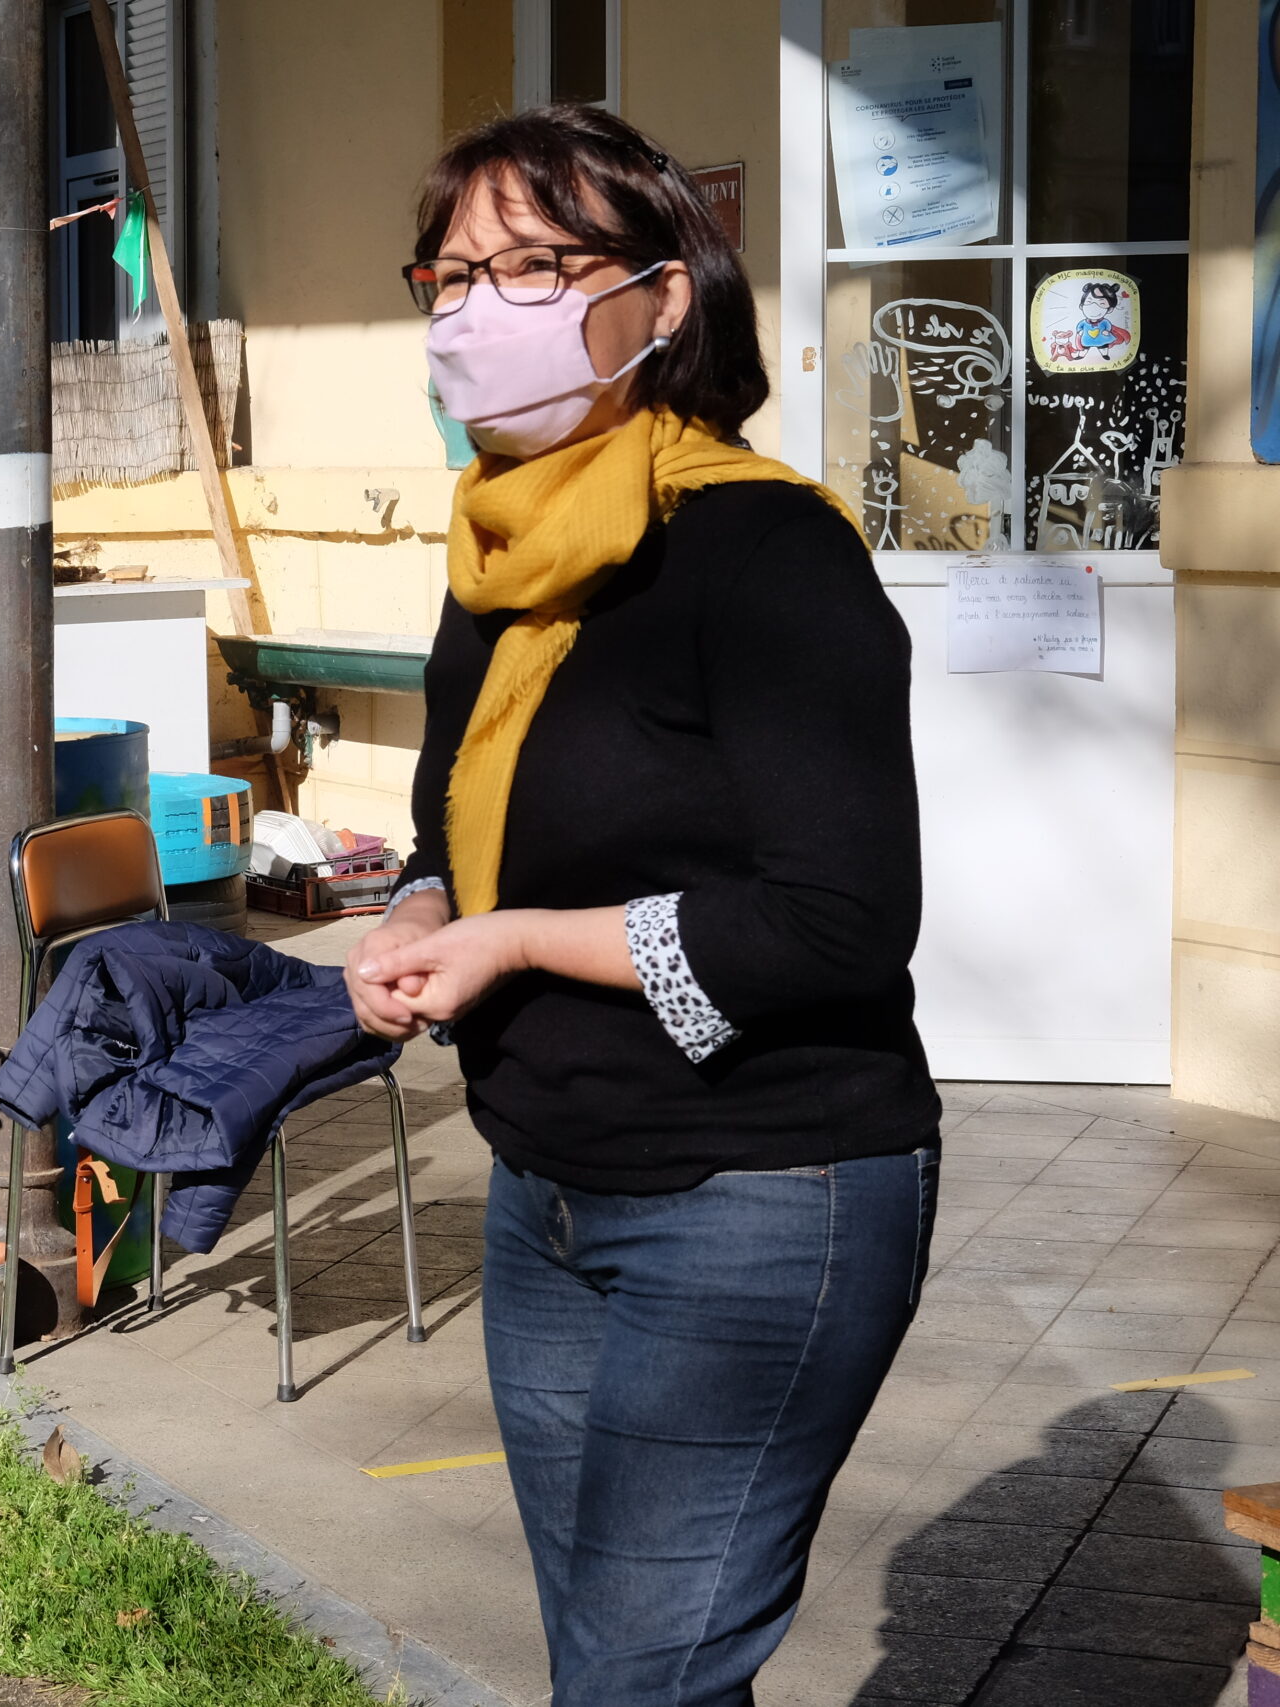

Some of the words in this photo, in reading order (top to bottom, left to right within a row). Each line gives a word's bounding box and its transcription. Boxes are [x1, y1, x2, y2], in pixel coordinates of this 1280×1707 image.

[926, 102, 951, 110] AUTRES
[700, 180, 738, 202] MENT
[1057, 272, 1071, 280] MJC
[1075, 270, 1104, 278] masque
[956, 570, 990, 590] Merci
